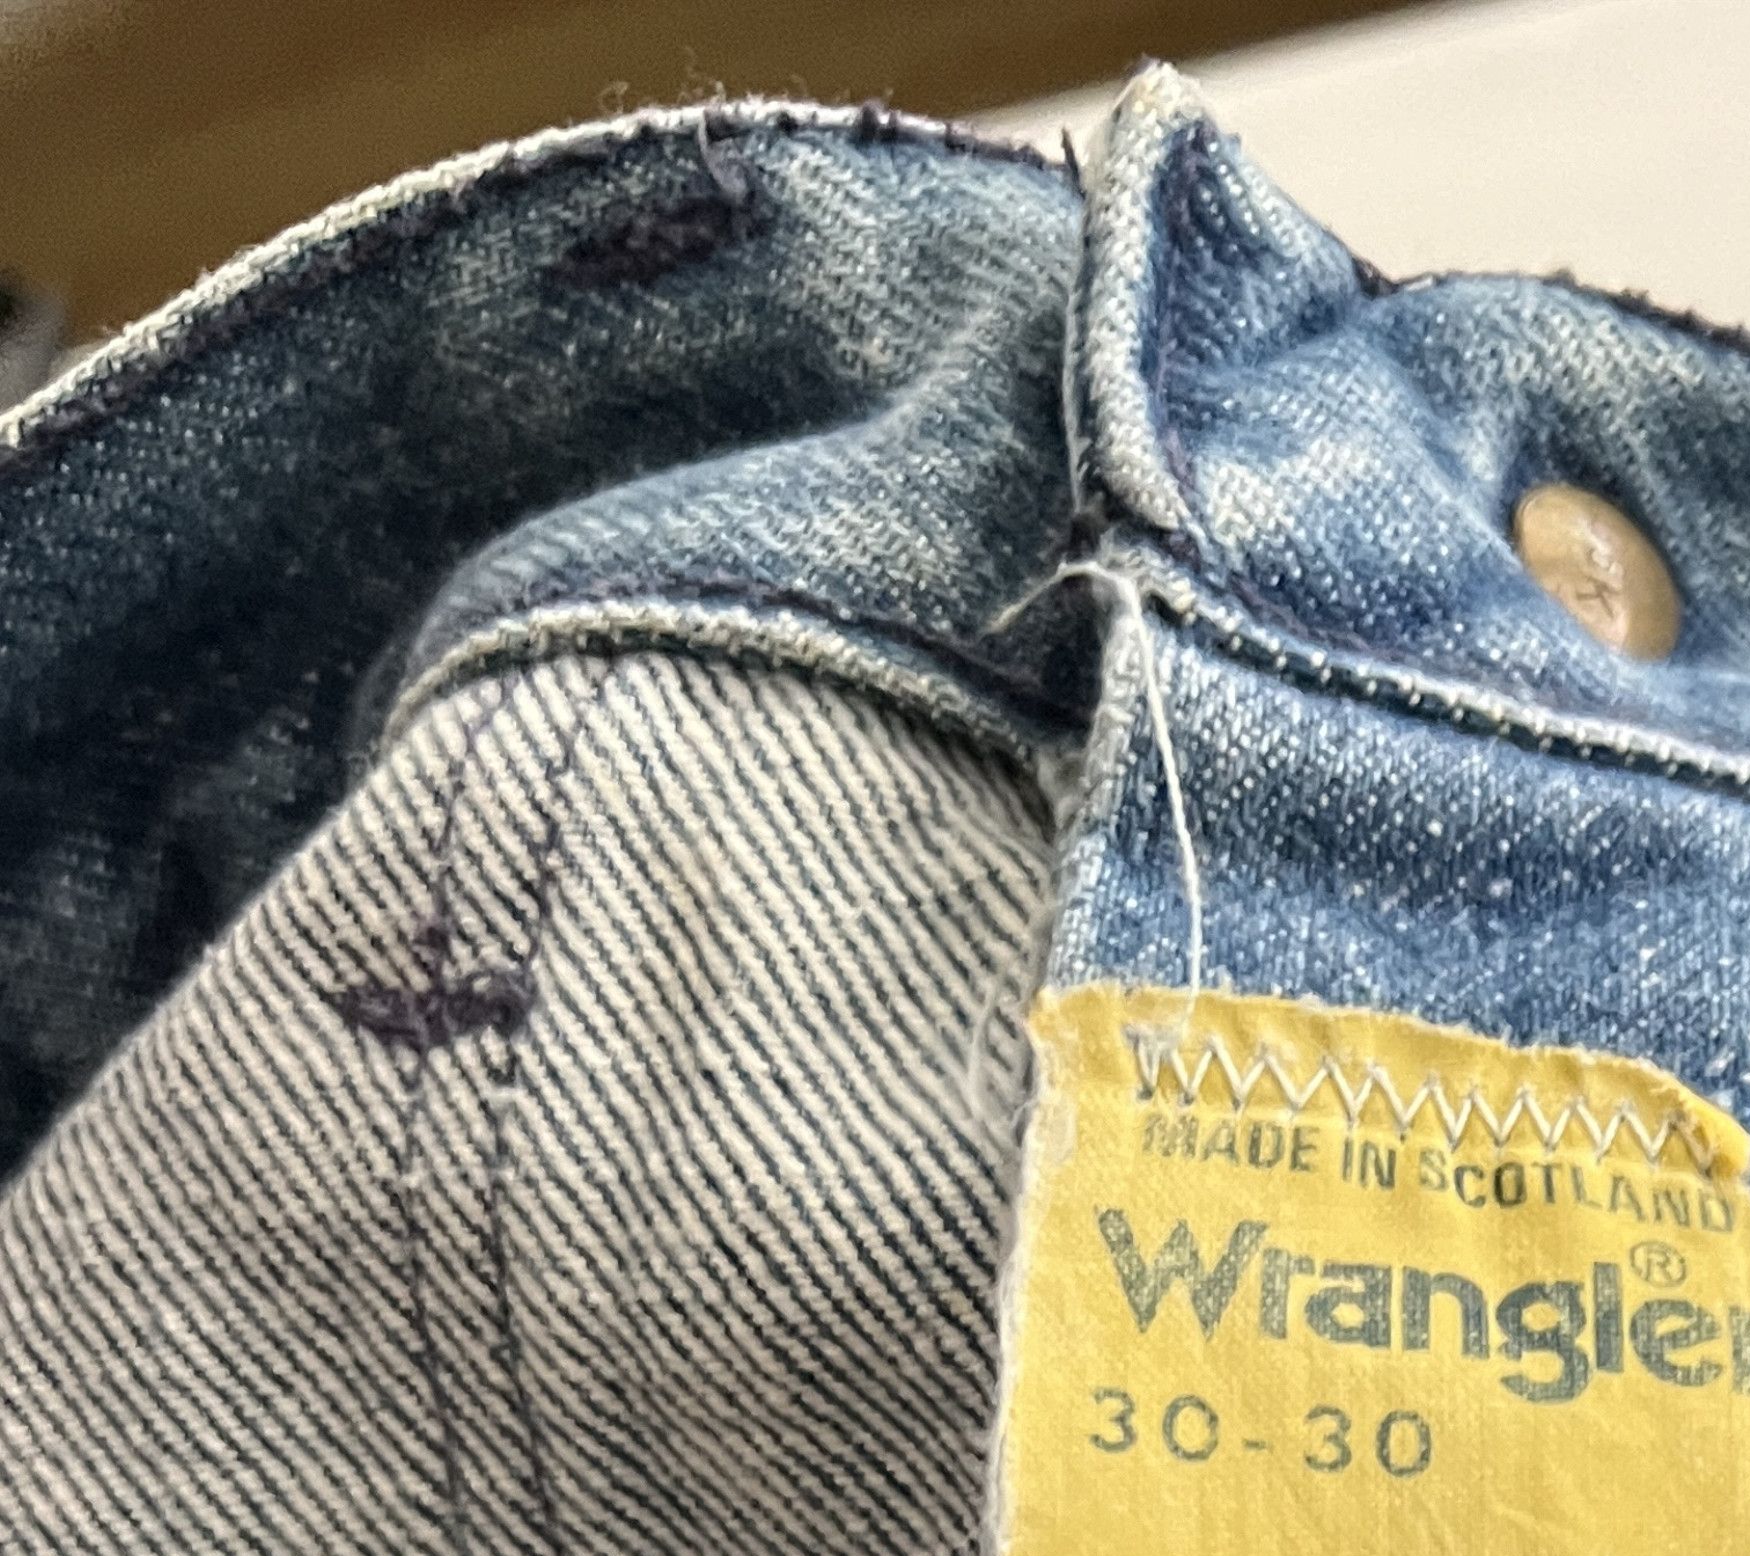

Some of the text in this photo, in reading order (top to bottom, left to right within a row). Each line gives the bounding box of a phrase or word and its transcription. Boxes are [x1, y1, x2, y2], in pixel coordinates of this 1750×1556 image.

[1139, 1113, 1740, 1233] MADE IN SCOTLAND
